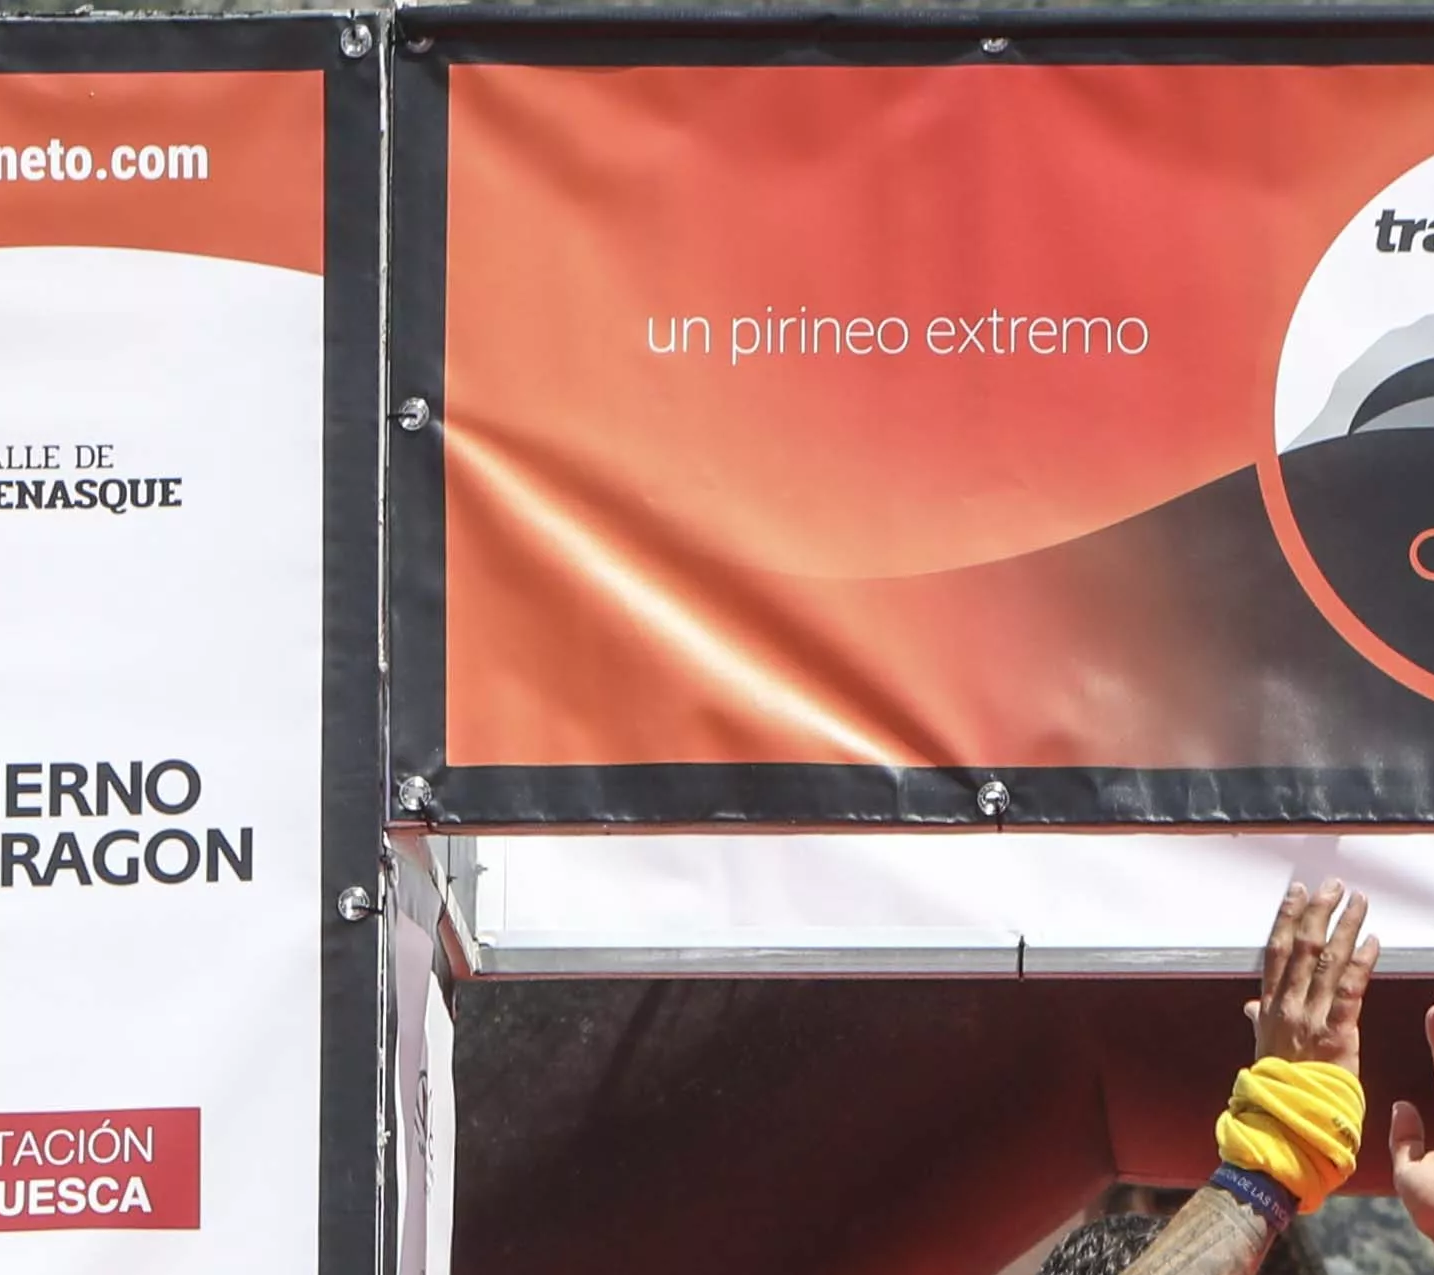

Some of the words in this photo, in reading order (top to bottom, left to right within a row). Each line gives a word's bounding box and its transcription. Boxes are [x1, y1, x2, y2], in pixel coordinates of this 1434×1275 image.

[648, 315, 711, 355] un
[732, 305, 910, 366] pirineo
[925, 307, 1150, 356] extremo
[75, 444, 115, 470] DE
